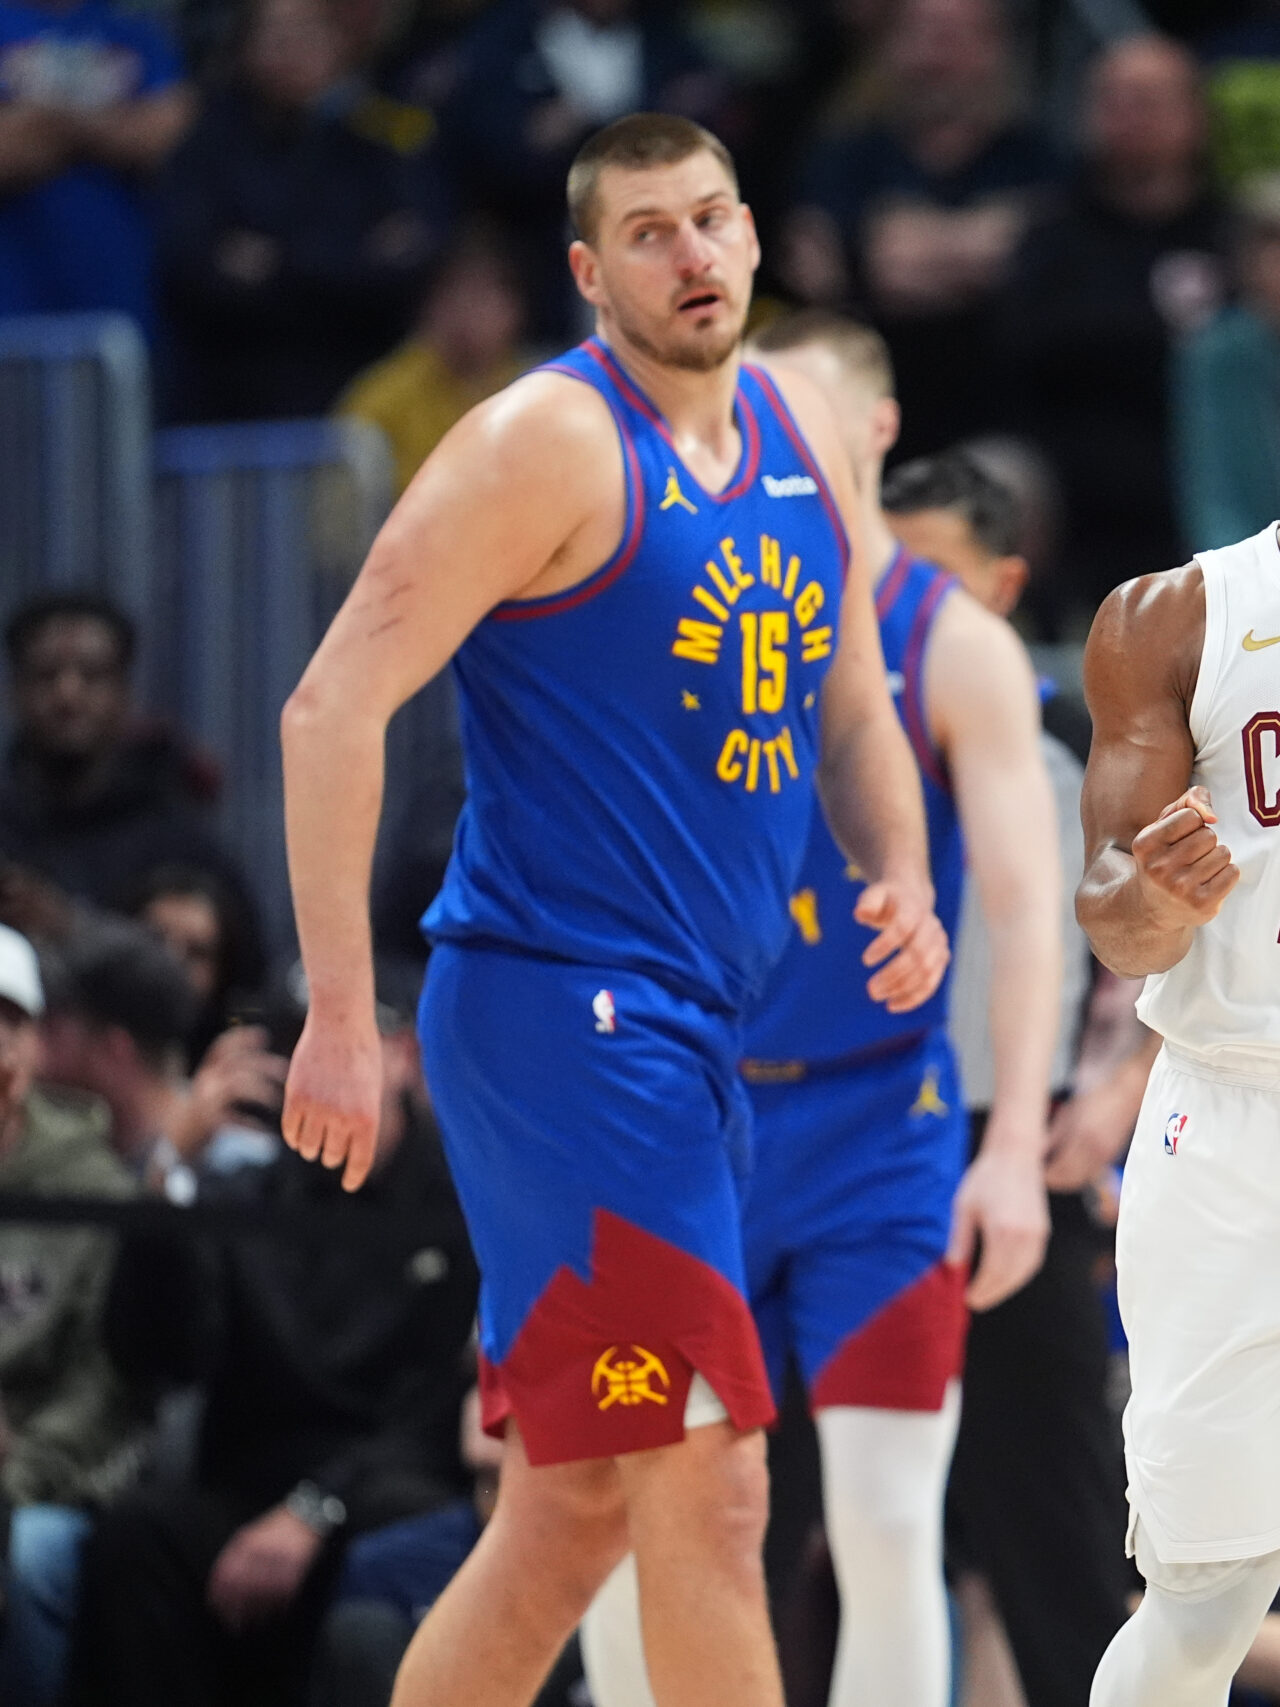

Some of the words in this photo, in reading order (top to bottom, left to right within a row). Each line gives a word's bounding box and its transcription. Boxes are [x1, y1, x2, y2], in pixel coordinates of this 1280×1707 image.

[672, 536, 755, 664] MILE
[759, 533, 832, 664] HIGH
[739, 611, 789, 715] 15
[716, 726, 799, 794] CITY
